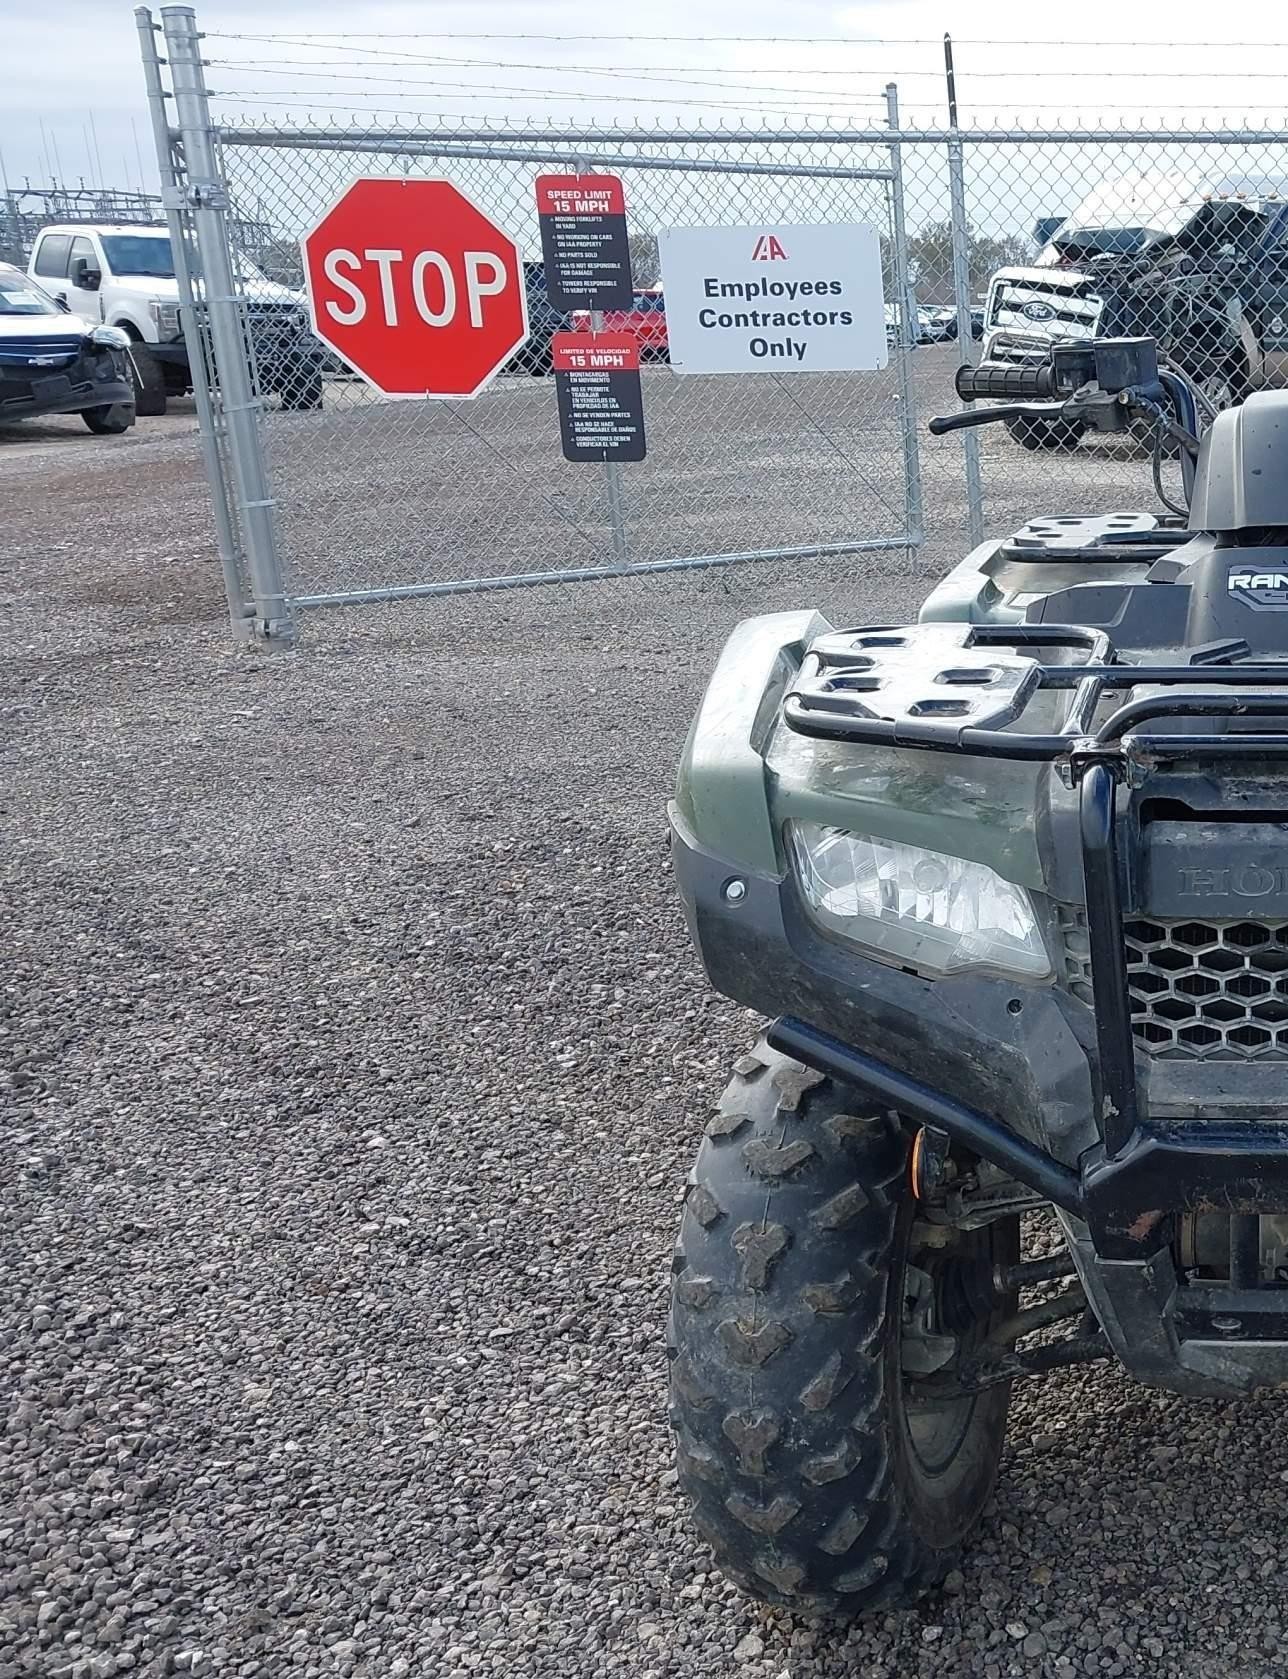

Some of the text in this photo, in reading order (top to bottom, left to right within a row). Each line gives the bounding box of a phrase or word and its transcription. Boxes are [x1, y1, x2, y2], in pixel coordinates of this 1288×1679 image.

[547, 190, 612, 199] SPEED LIMIT
[553, 200, 609, 212] 15 MPH
[323, 248, 509, 328] STOP
[704, 277, 842, 302] Employees
[699, 308, 853, 328] Contractors
[749, 337, 807, 361] Only
[569, 355, 624, 367] 15 MPH
